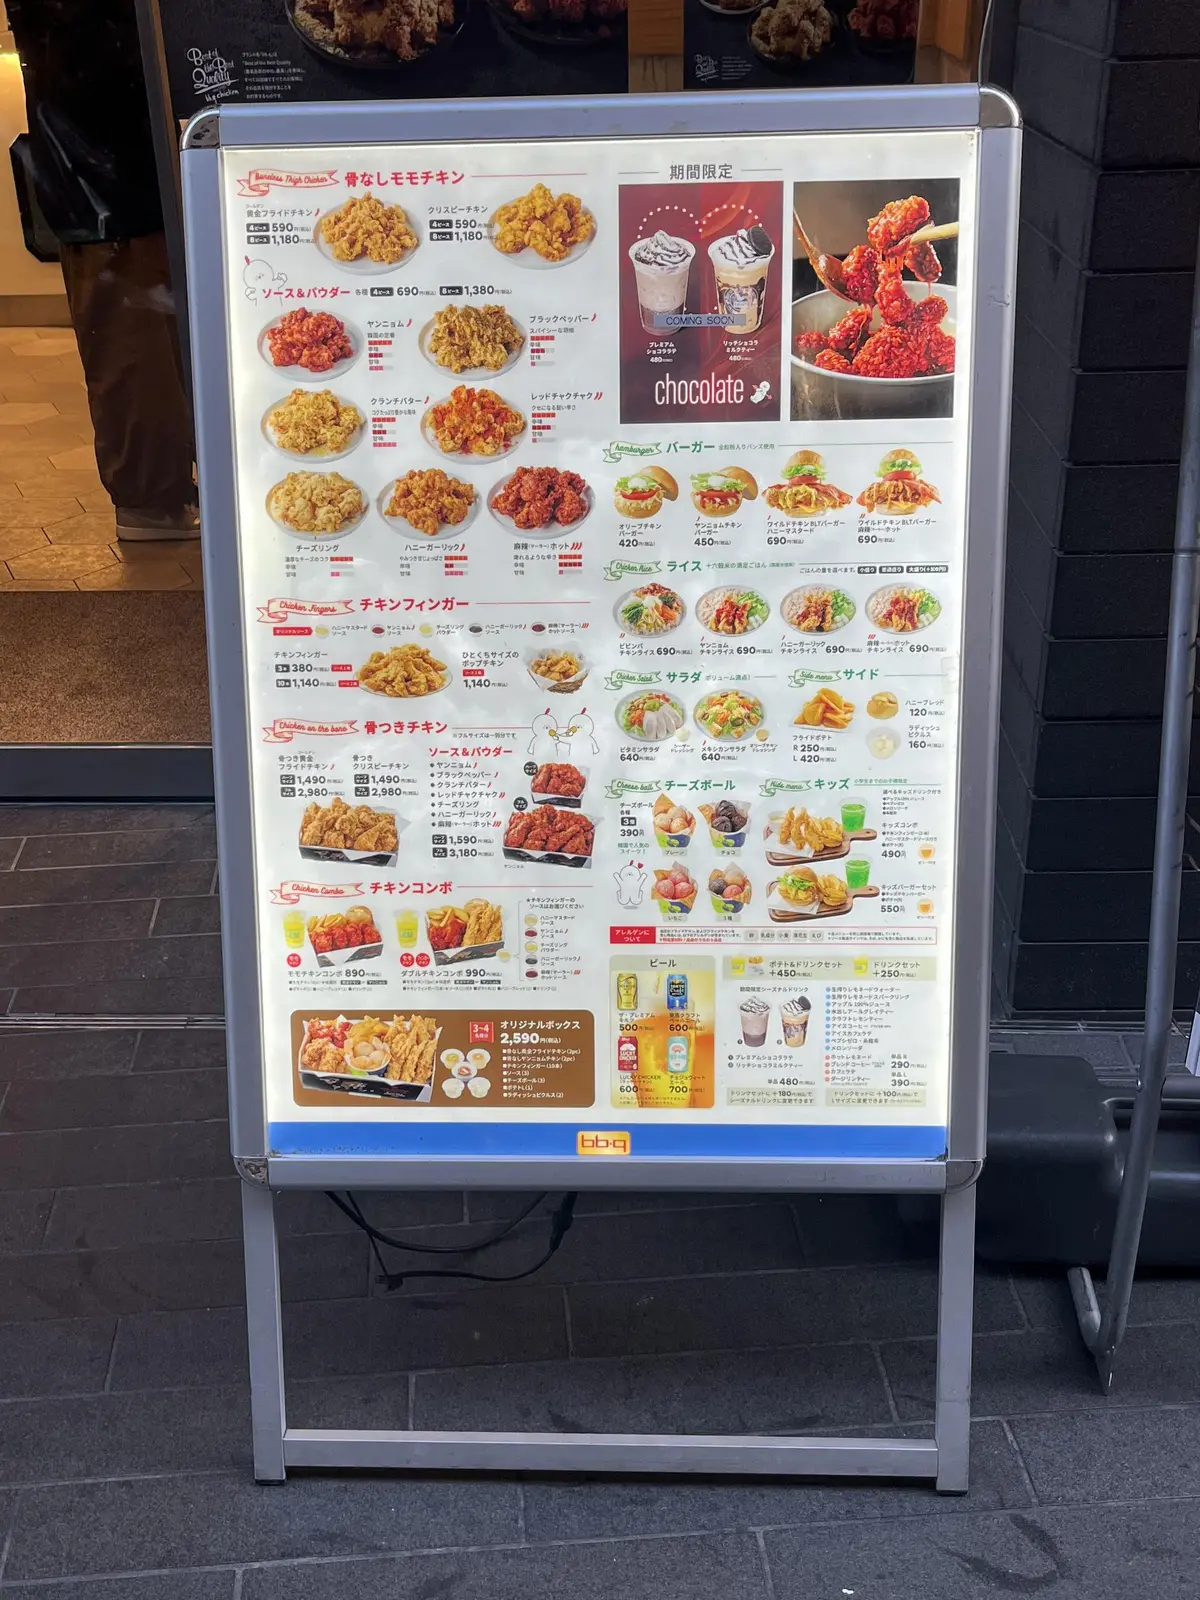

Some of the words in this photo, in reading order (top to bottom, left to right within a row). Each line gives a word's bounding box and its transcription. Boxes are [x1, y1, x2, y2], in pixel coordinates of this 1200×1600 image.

[669, 163, 733, 180] 期間限定
[285, 175, 303, 186] Thigh
[304, 175, 328, 184] Chicken
[345, 170, 465, 187] 骨なしモモチキン
[246, 208, 313, 218] 黄金フライドチキン
[428, 205, 488, 214] クリスピーチキン
[262, 286, 350, 299] ソース&パウダー
[367, 320, 404, 328] ヤンニョム
[529, 315, 589, 323] ブラックペッパー
[666, 316, 702, 326] COMING
[707, 316, 735, 324] SOON
[655, 372, 744, 405] chocolate
[370, 397, 422, 405] クランチバター
[531, 392, 593, 400] レッドチャクチャク
[615, 444, 655, 456] hamburger
[666, 441, 715, 453] バーガー
[296, 544, 340, 552] チーズリング
[405, 543, 459, 551] ハニーガーリック
[616, 562, 638, 571] Chicken
[639, 564, 652, 572] Rice
[667, 561, 702, 572] ライス
[279, 600, 307, 611] Chicken
[360, 597, 469, 612] チキンフィンガー
[273, 651, 328, 659] チキンフィンガー
[462, 651, 519, 659] ひとくちサイズの
[616, 672, 636, 681] Chicken
[637, 674, 653, 682] Salad
[666, 671, 702, 683] サラダ
[800, 671, 814, 680] Side
[843, 669, 880, 680] サイド
[279, 722, 305, 730] Chicken
[317, 724, 329, 733] the
[364, 720, 448, 735] 骨つきチキン
[429, 746, 513, 758] ソース&パウダー
[436, 771, 491, 779] ブラックペッパー
[616, 780, 639, 790] Cheese
[665, 779, 736, 791] チーズボール
[814, 778, 850, 790] キッズ
[291, 884, 318, 893] Chicken
[320, 887, 345, 895] Combo
[370, 881, 452, 895] チキンコンボ
[650, 958, 677, 967] ビール
[500, 1020, 581, 1030] オリジナルボックス
